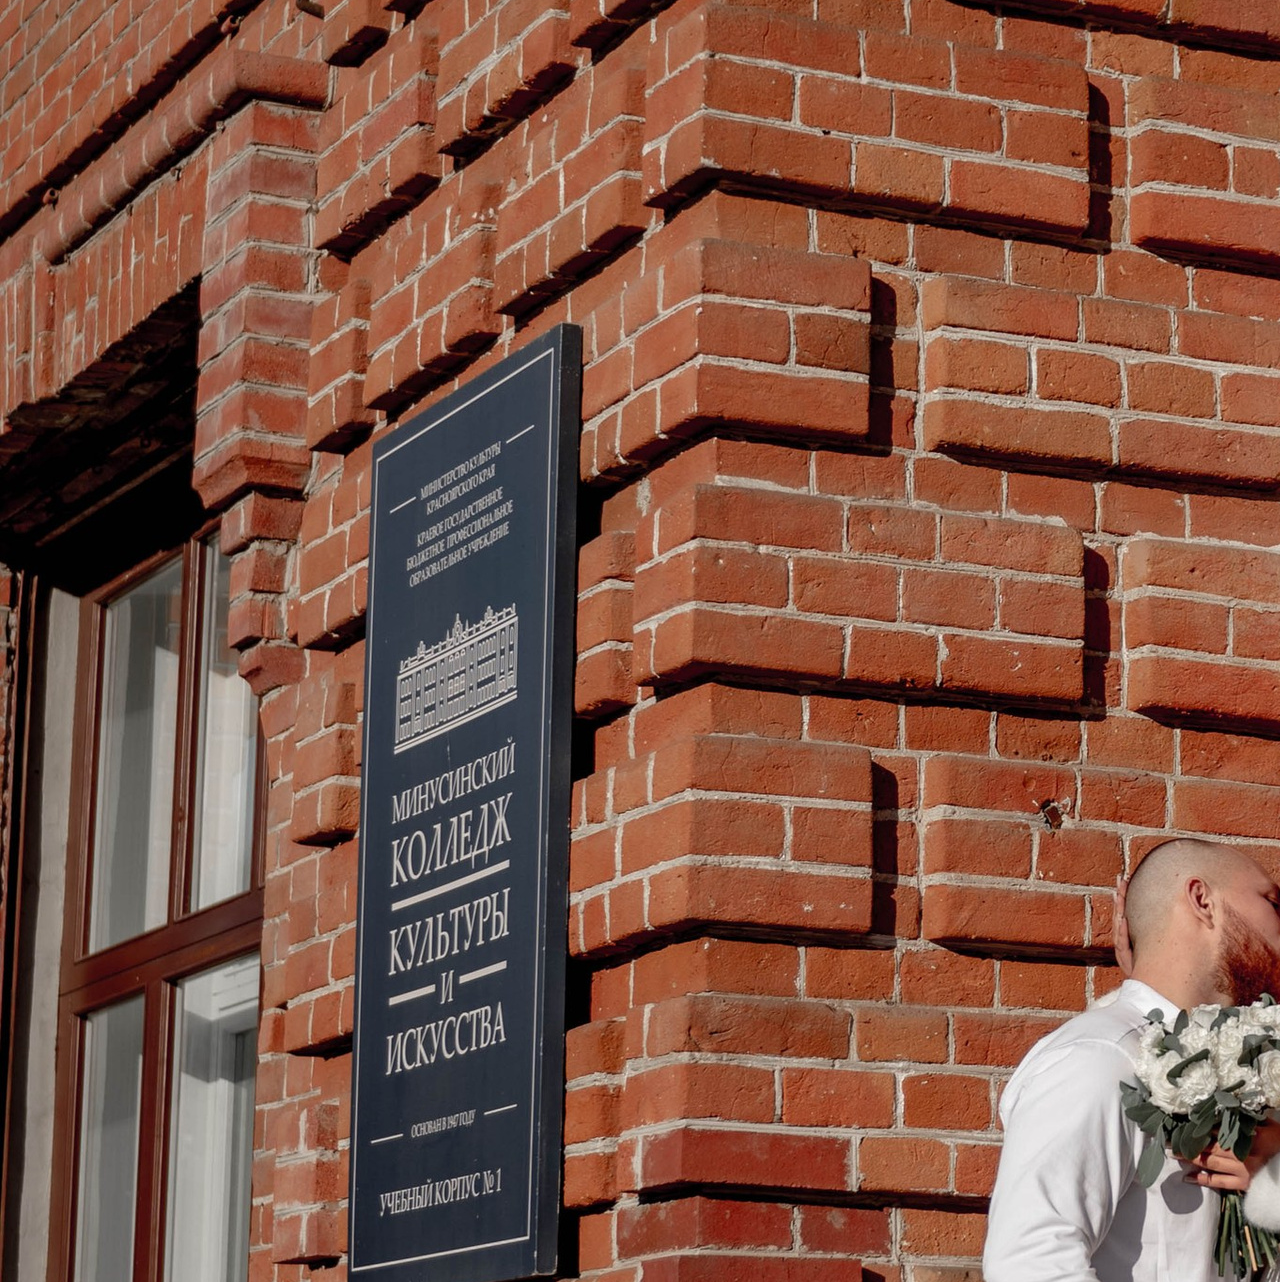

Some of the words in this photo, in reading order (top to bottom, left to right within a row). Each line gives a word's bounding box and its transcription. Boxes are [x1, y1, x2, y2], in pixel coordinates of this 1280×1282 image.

[420, 461, 470, 500] МИНИСТЕРСТВО
[469, 440, 502, 471] КУЛЬТУРЫ
[426, 474, 479, 515] КРАСНОЯРСКОГО
[478, 463, 496, 485] КРАЯ
[406, 538, 446, 571] БЮДЖЕТНОЕ
[446, 499, 513, 549] ПРОФЕССИОНАЛЬНОЕ
[417, 520, 445, 547] КРАЕВОЕ
[444, 486, 503, 532] ГОСУДАРСТВЕННОЕ
[409, 544, 468, 587] ОБРАЗОВАТЕЛЬНОЕ
[467, 521, 510, 556] УЧРЕЖДЕНИЕ
[391, 736, 516, 825] МИНУСИНСКИЙ
[390, 792, 513, 888] КОЛЛЕДЖ
[388, 887, 511, 976] КУЛЬТУРЫ
[440, 969, 455, 1005] И
[385, 1001, 507, 1076] ИСКУССТВА
[411, 1117, 442, 1138] ОСНОВАН
[459, 1108, 477, 1127] ГОДУ
[379, 1178, 434, 1217] УЧЕБНЫЙ
[434, 1172, 481, 1206] КОРПУС
[482, 1169, 495, 1196] №
[496, 1167, 502, 1192] 1
